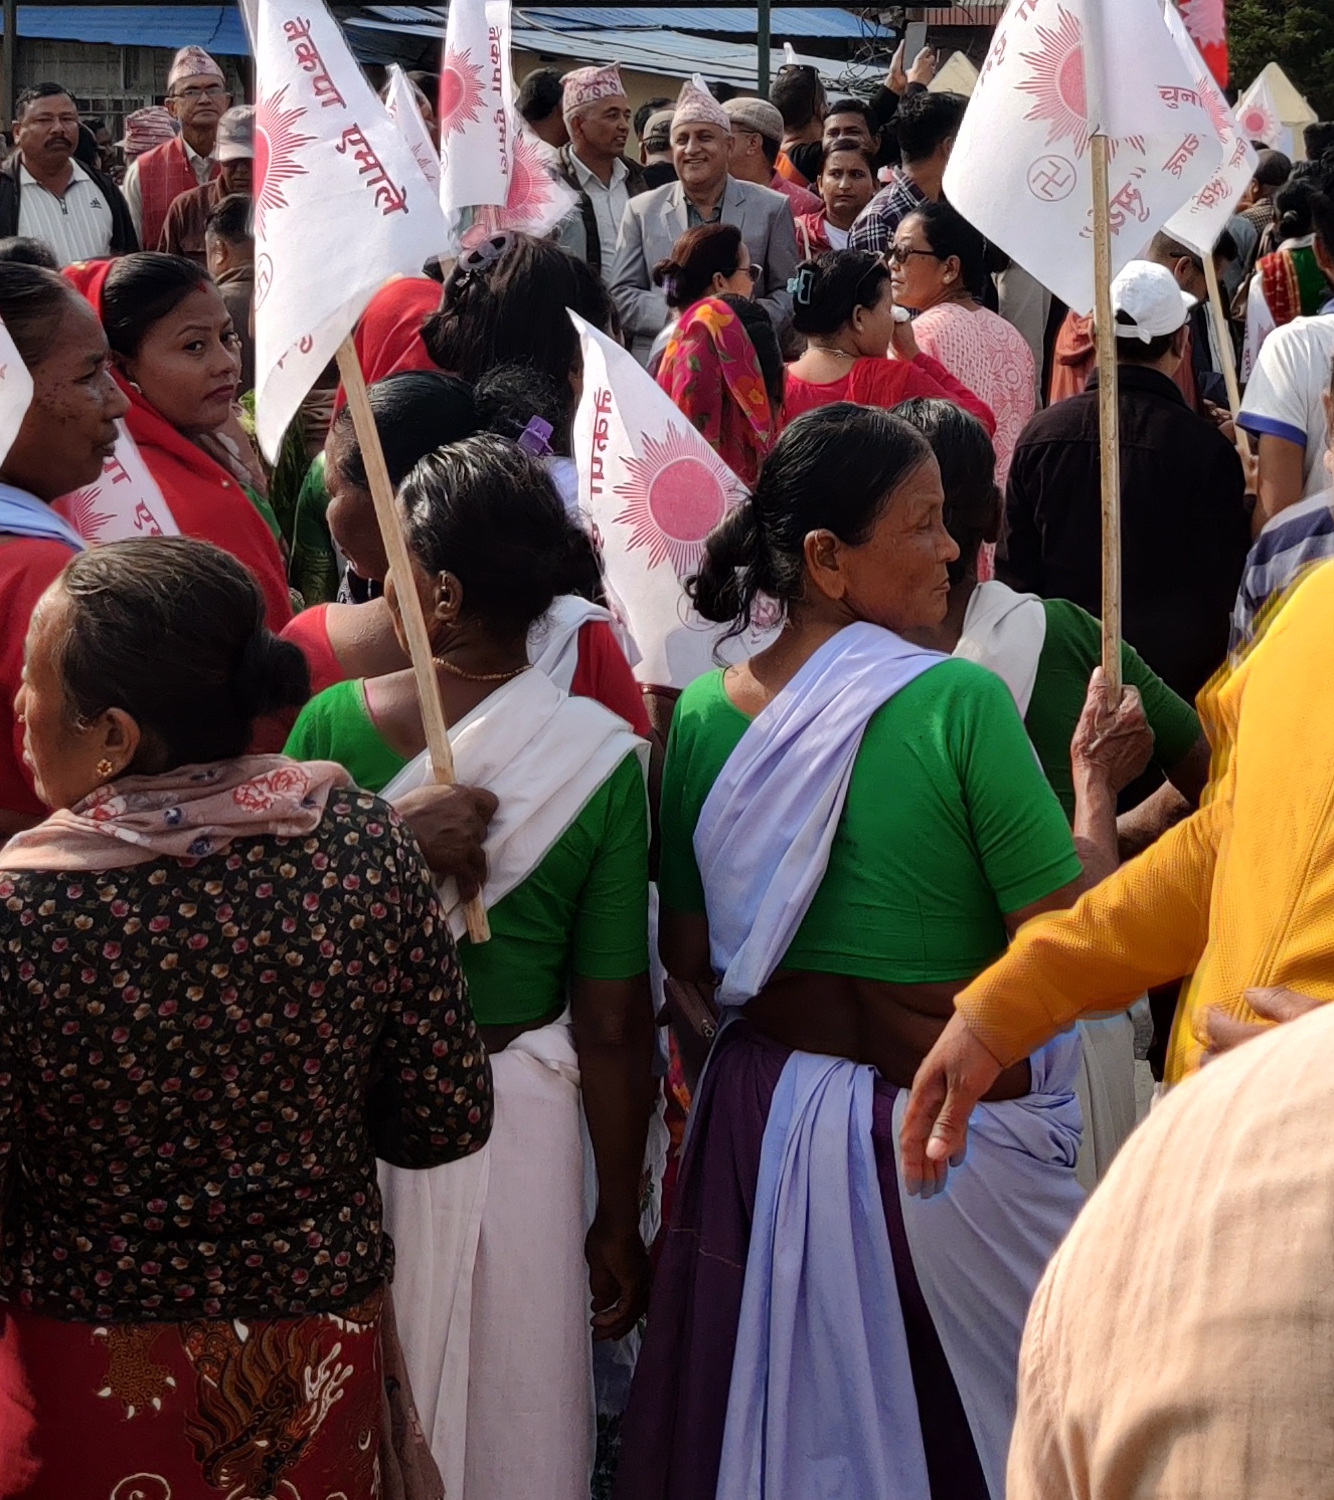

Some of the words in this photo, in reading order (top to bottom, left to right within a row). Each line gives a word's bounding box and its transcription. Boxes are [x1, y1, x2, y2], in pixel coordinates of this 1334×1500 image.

[487, 24, 504, 98] नेकपा
[1157, 85, 1203, 109] चुना
[283, 16, 347, 109] नेकपा
[334, 122, 410, 217] एमाले
